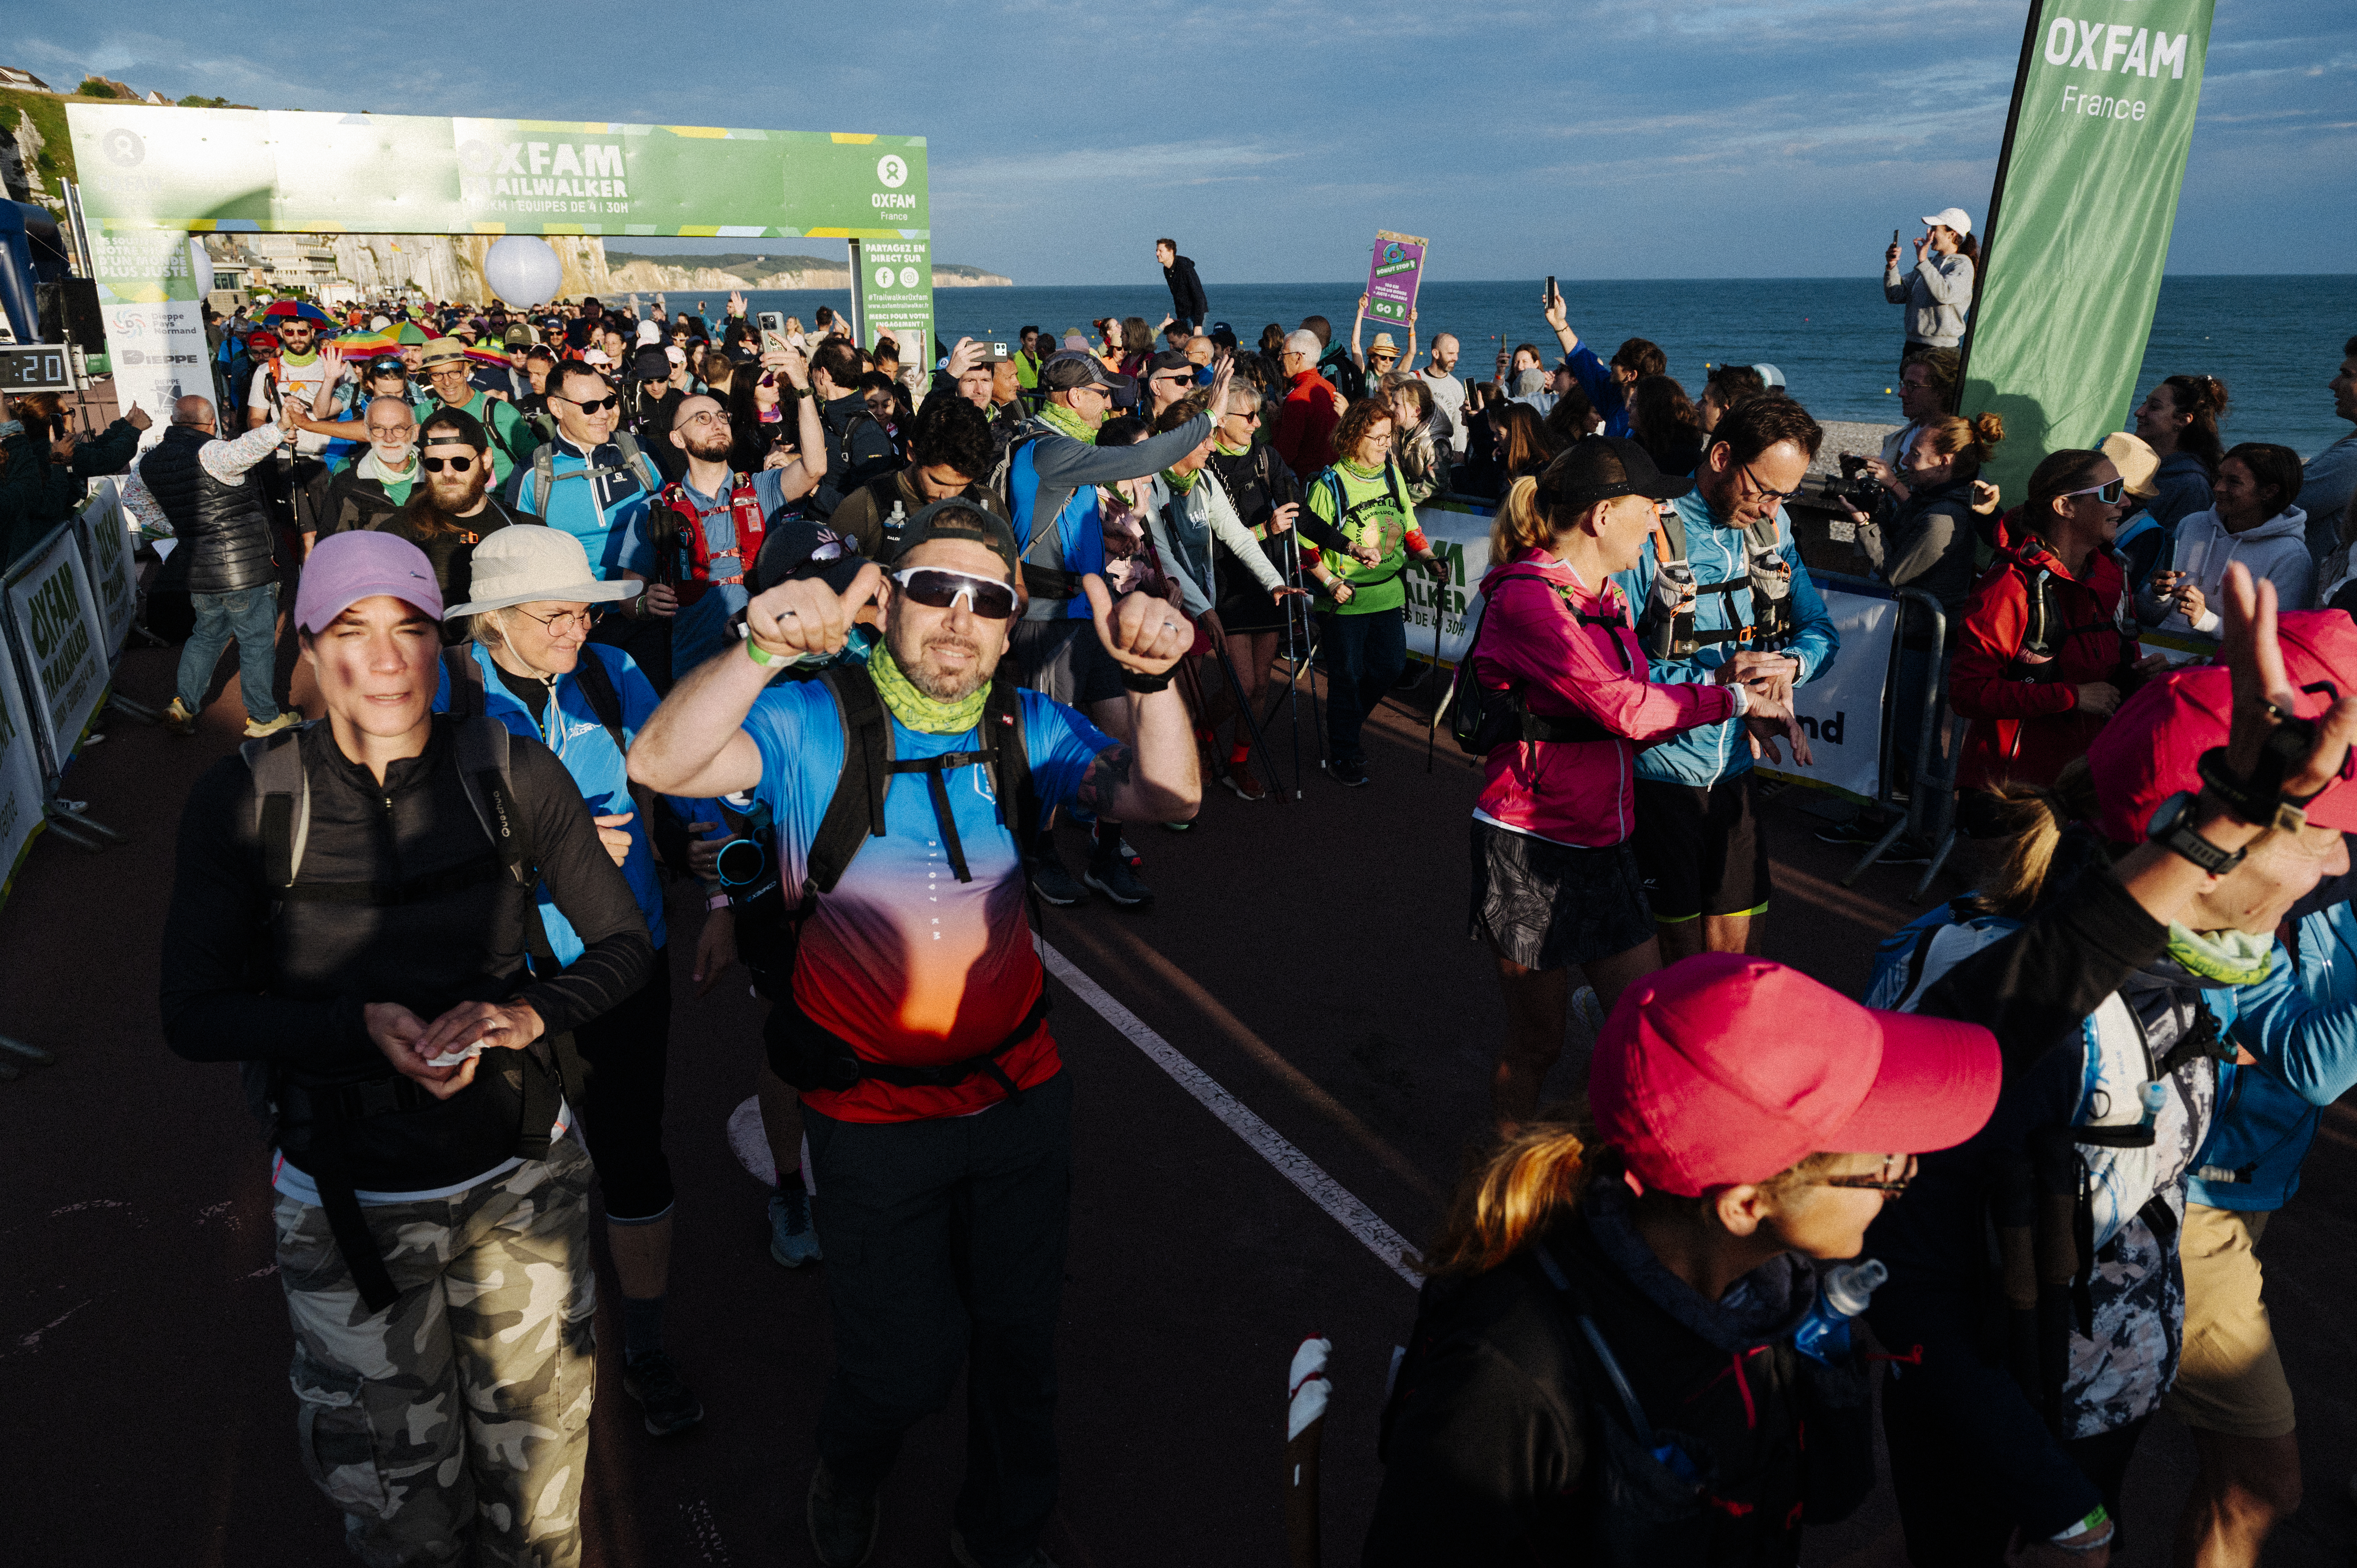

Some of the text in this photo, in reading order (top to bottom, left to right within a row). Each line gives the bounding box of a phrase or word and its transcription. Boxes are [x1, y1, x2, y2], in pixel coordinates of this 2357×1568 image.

[2044, 17, 2188, 79] OXFAM
[2060, 85, 2146, 121] France
[459, 139, 625, 177] OXFAM
[518, 200, 567, 212] EQUIPES
[571, 201, 585, 212] DE
[589, 201, 596, 212] 4
[606, 202, 629, 213] 30H
[871, 193, 916, 208] OXFAM
[881, 212, 908, 221] France
[866, 244, 926, 253] PARTAGEZ EN
[136, 256, 187, 266] MONDE
[871, 254, 922, 263] DIRECT SUR
[100, 266, 189, 277] PLUS JUSTE
[1376, 263, 1410, 275] DONUT STOP
[1376, 303, 1391, 314] GO
[152, 313, 184, 321] Dieppe
[122, 350, 198, 365] DIEPPE
[1363, 510, 1394, 521] MARIE-LUCE
[1379, 553, 1395, 565] RCEAU
[28, 561, 81, 660] OXFAM
[1415, 611, 1428, 627] DE
[1445, 619, 1466, 637] 30H
[493, 790, 511, 838] Quechua
